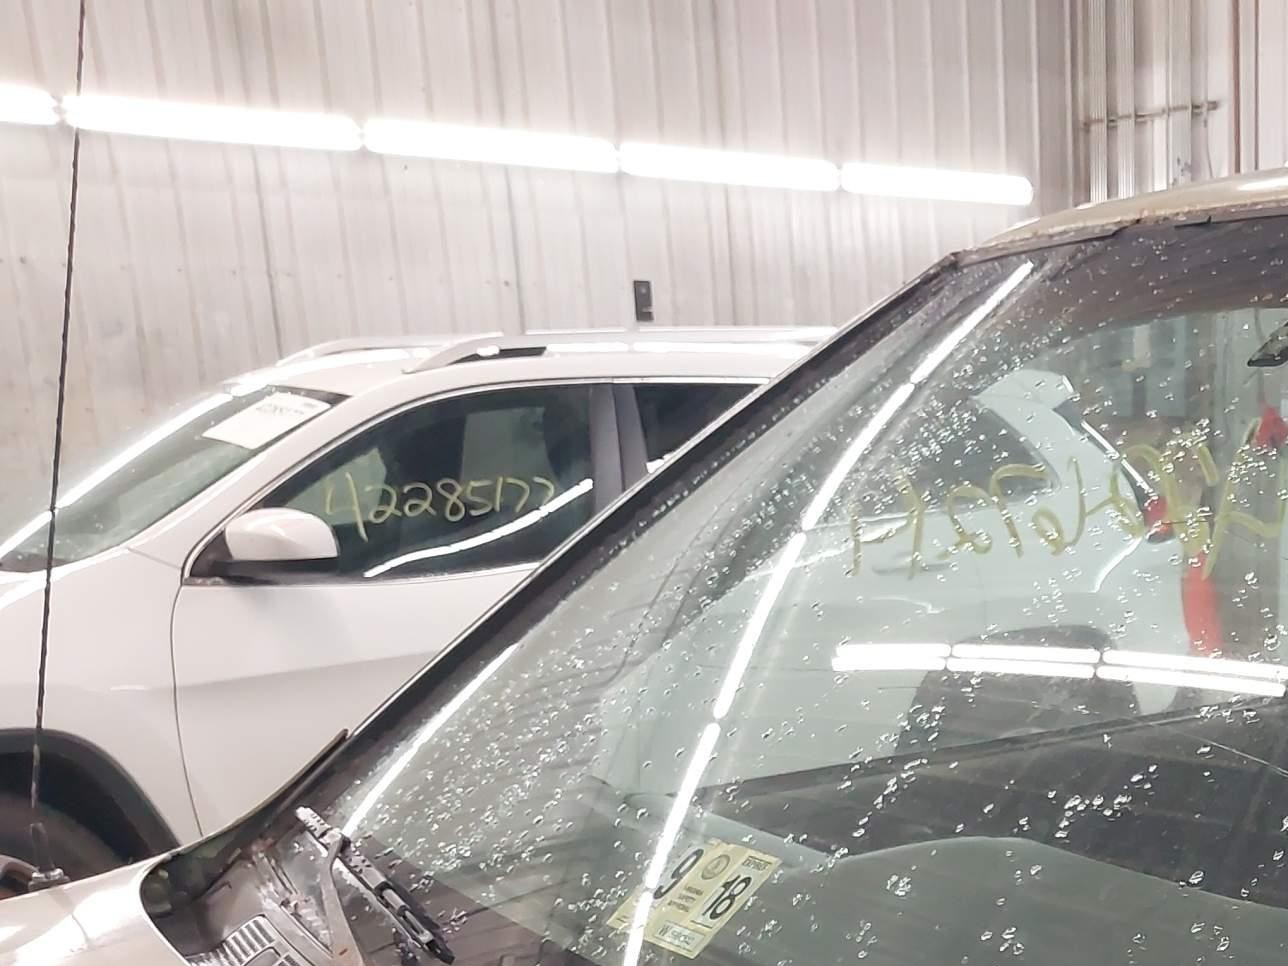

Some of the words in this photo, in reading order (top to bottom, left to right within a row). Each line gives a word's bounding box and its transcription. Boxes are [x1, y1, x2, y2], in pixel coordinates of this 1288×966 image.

[325, 471, 557, 543] 42285177
[652, 848, 704, 900] 9
[701, 874, 753, 920] 18
